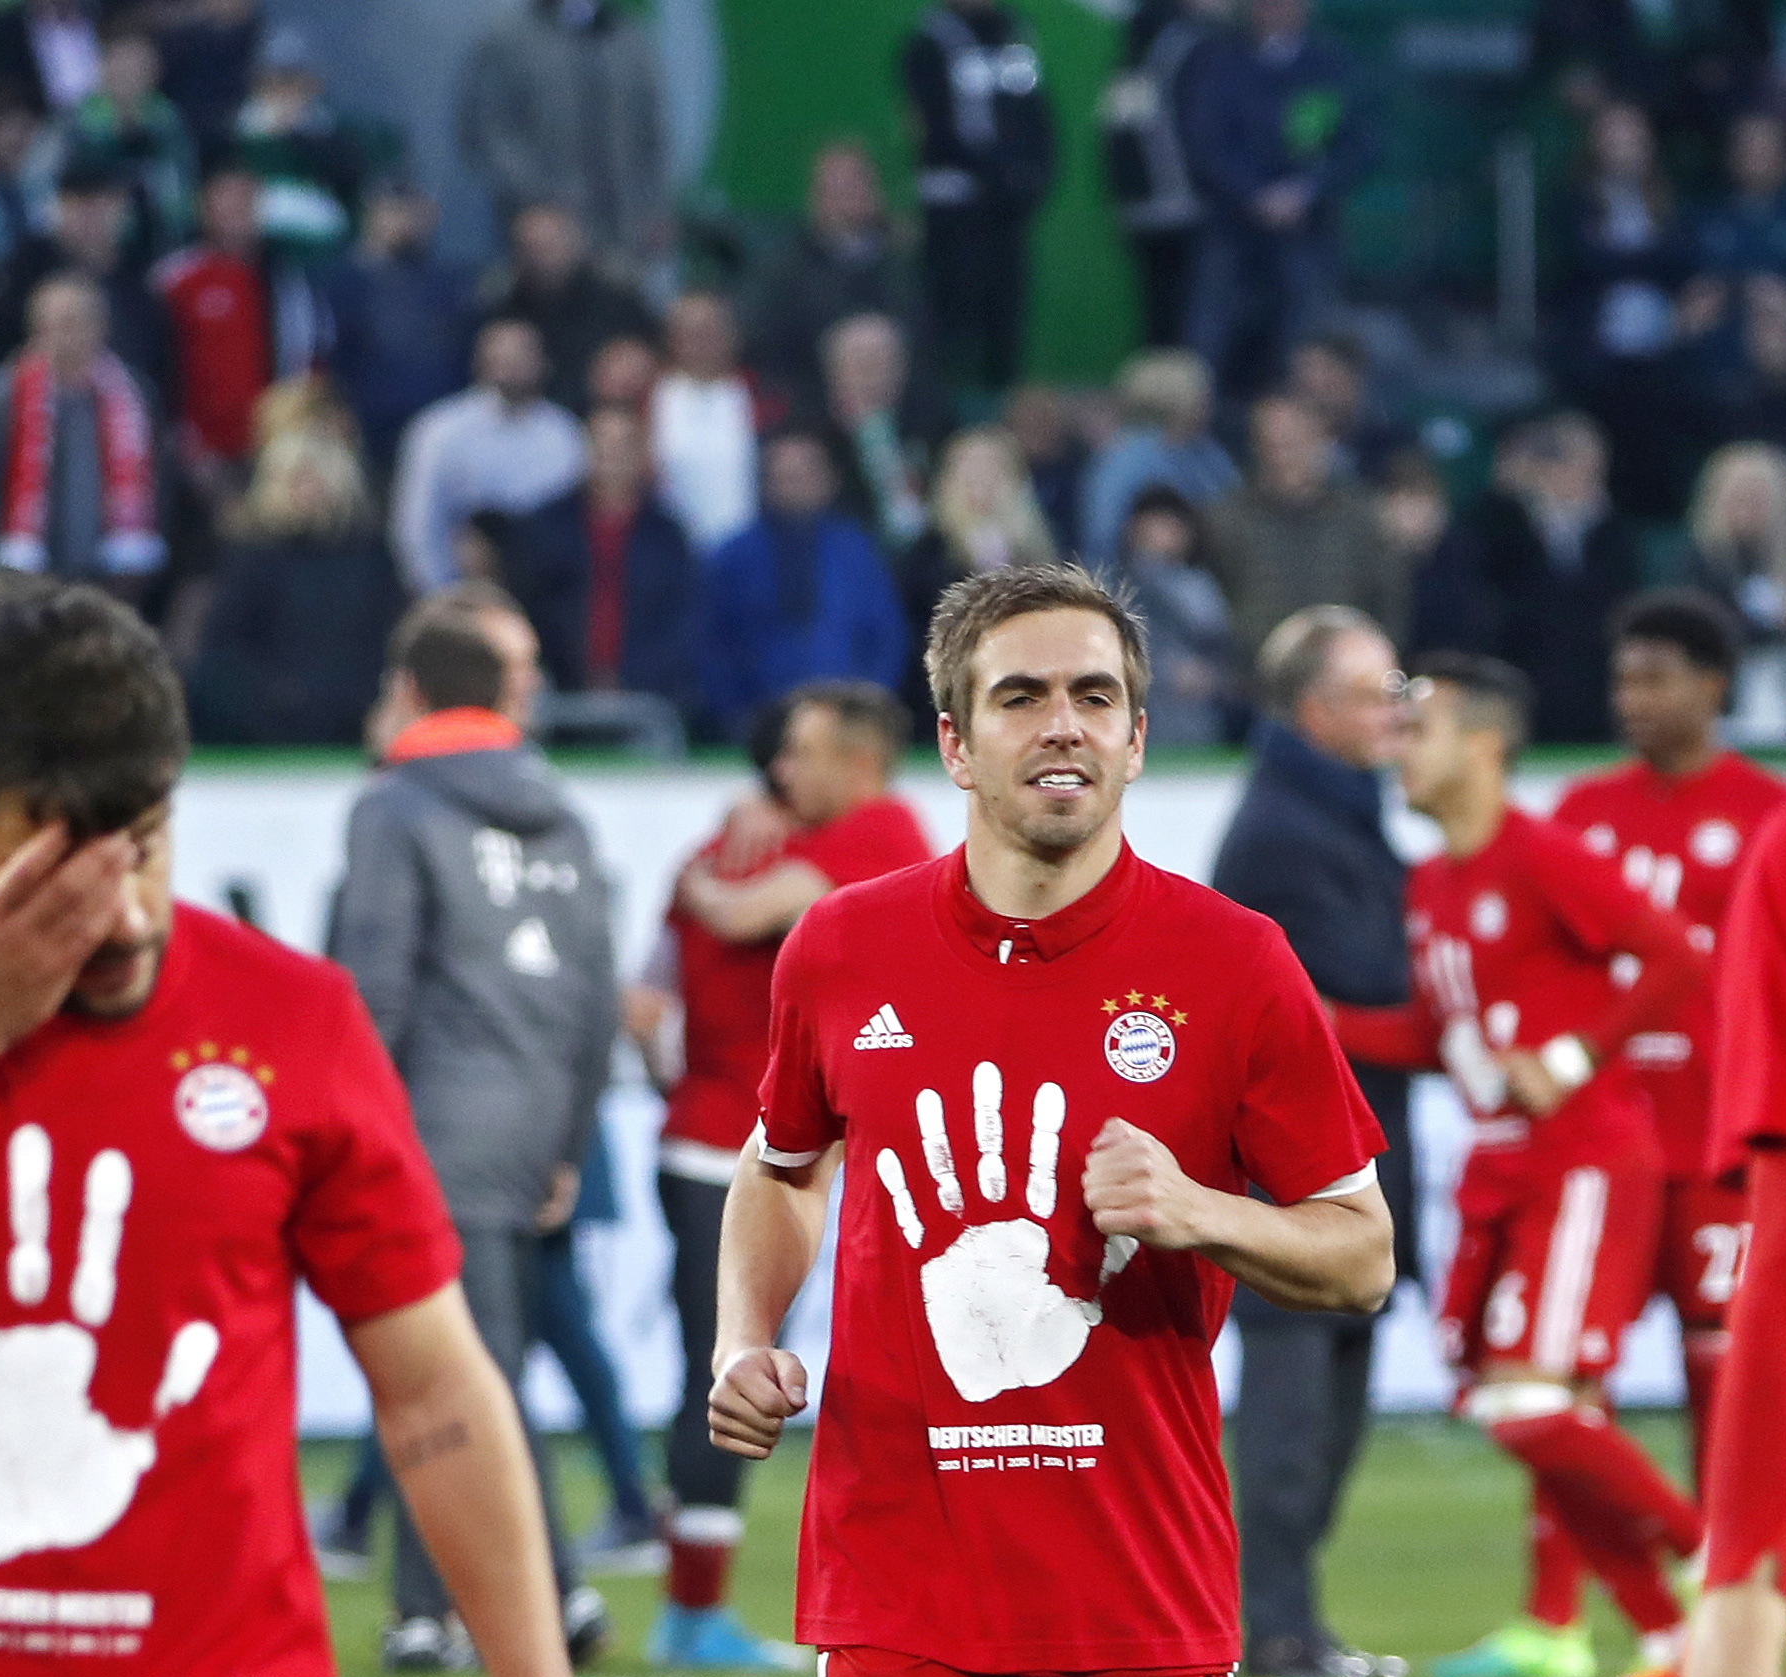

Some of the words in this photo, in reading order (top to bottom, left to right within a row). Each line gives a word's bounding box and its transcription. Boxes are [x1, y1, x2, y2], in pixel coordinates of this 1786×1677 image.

[853, 1033, 914, 1051] adidas
[928, 1424, 1030, 1449] DEUTSCHER
[1030, 1424, 1104, 1448] MEISTER
